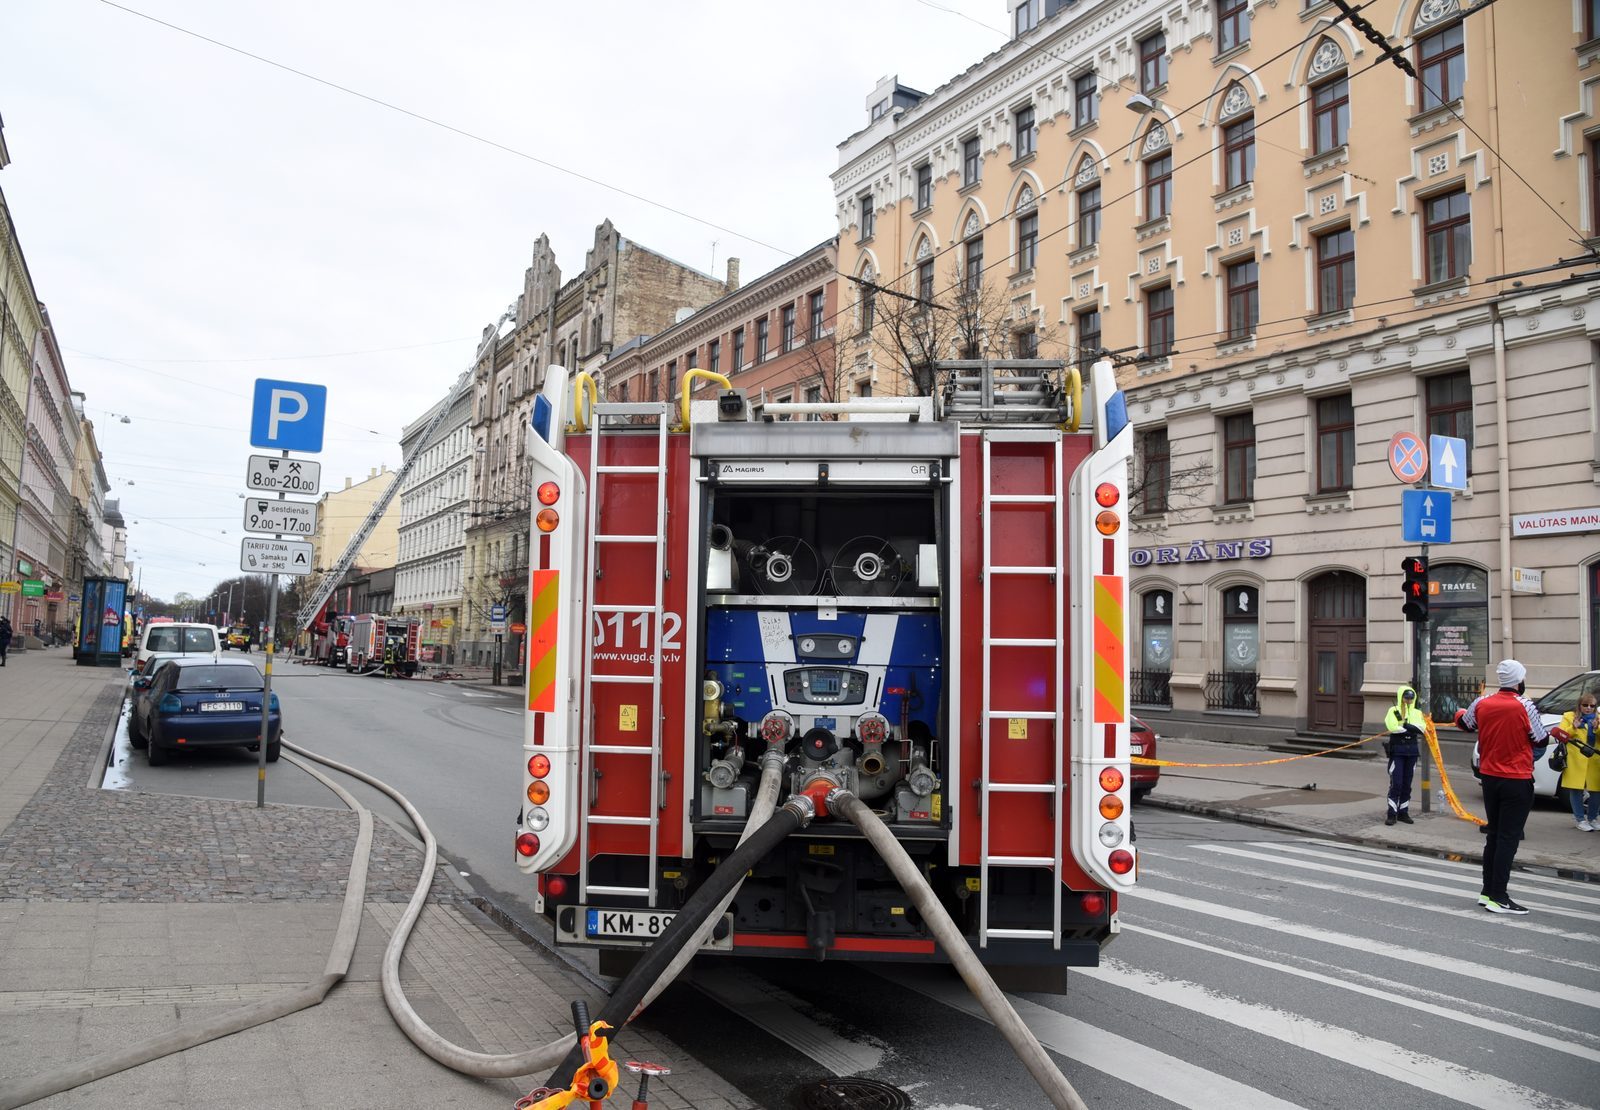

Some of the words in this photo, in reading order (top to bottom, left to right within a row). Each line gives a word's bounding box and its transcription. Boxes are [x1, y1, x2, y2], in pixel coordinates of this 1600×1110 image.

[268, 388, 309, 440] P
[911, 466, 926, 474] GR
[253, 472, 314, 490] 8.00-20.00
[271, 506, 309, 515] sestdienās
[1519, 518, 1567, 529] VALŪTAS
[1570, 515, 1600, 526] MAIŅ
[247, 542, 269, 550] TARIFU
[261, 553, 287, 561] Samaksa
[1131, 539, 1272, 566] ORĀNS
[295, 553, 306, 563] A
[1522, 574, 1540, 582] TRAVEL
[607, 612, 681, 649] 112
[593, 652, 680, 663] www.vugd.gv.lv
